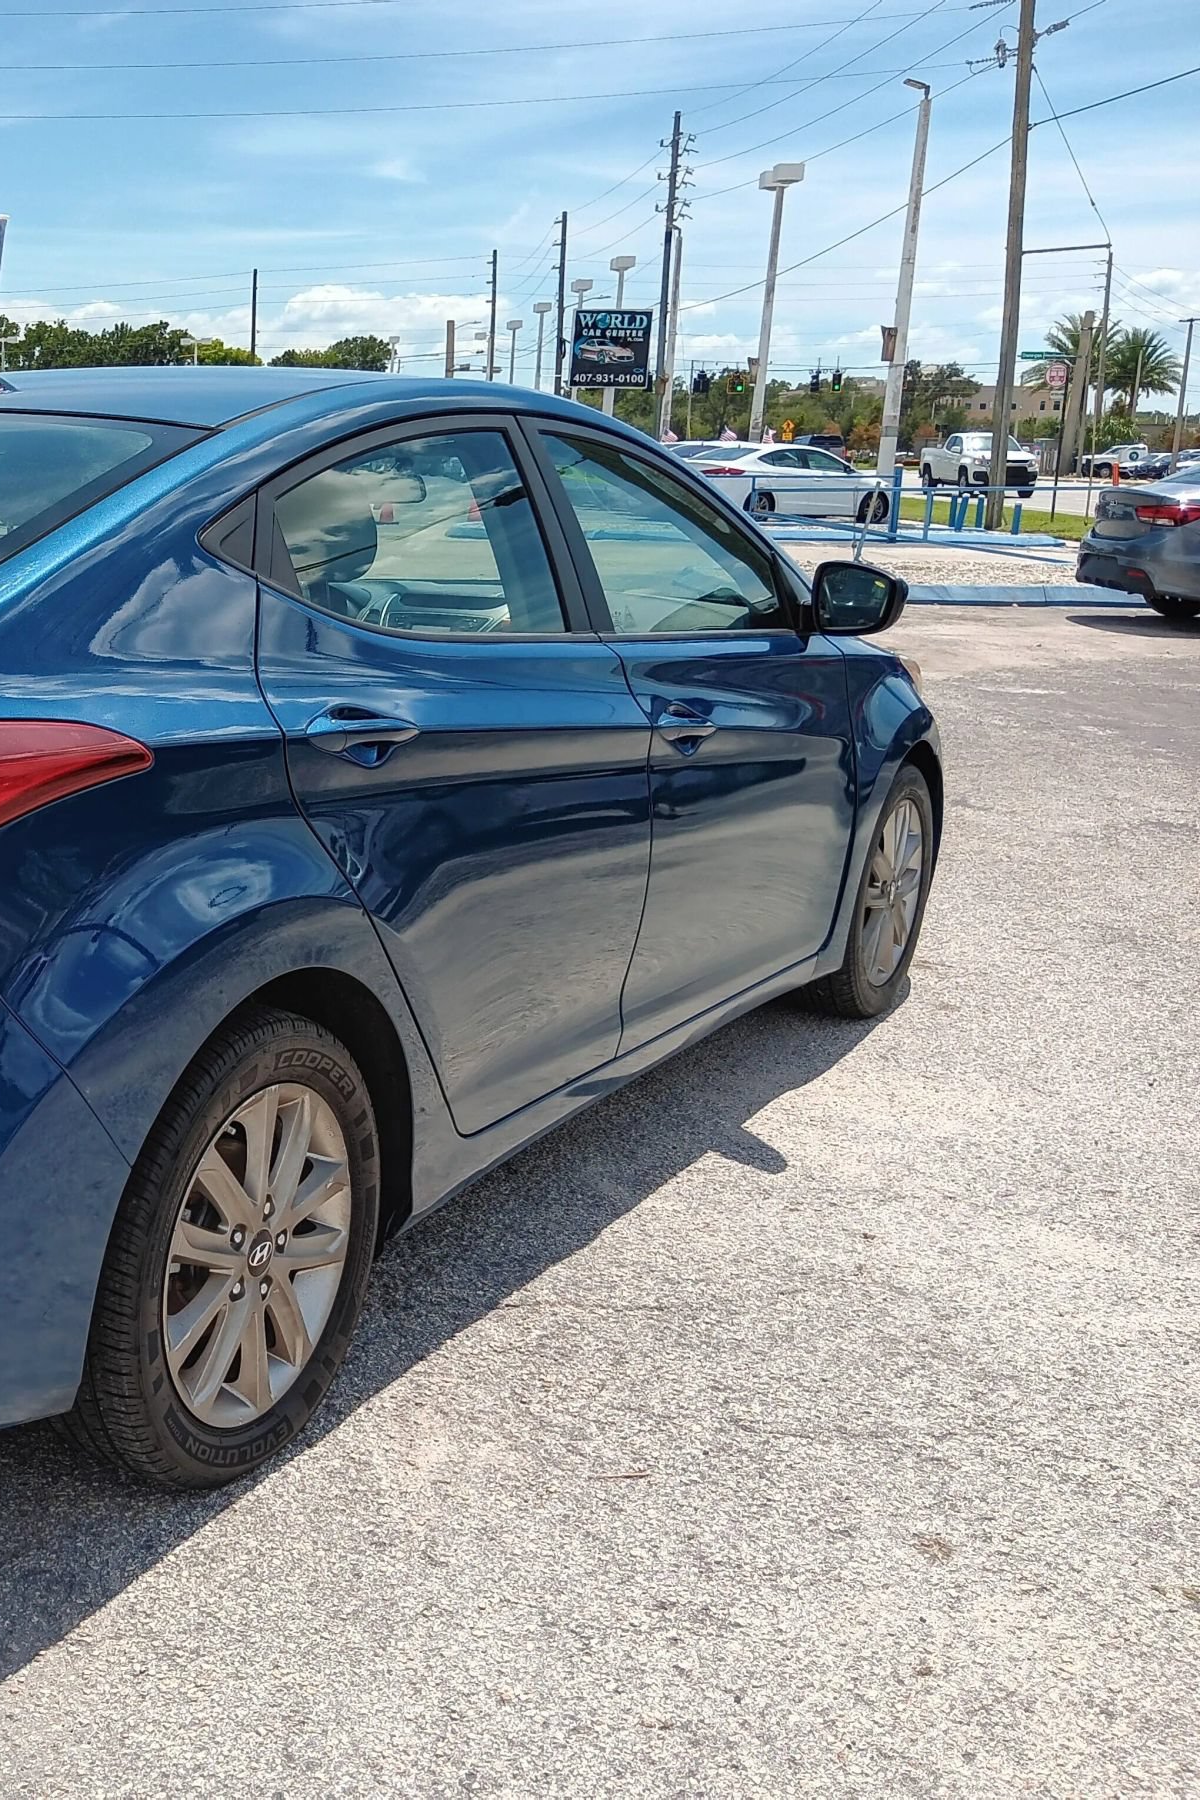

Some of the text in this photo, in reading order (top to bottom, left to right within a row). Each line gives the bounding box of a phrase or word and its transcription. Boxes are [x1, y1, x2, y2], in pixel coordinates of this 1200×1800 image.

[578, 312, 648, 329] WORLD
[606, 329, 644, 337] CENTER
[573, 373, 644, 383] 407-931-0100
[276, 1049, 354, 1097] COOPER
[185, 1421, 288, 1465] EVOLUTION
